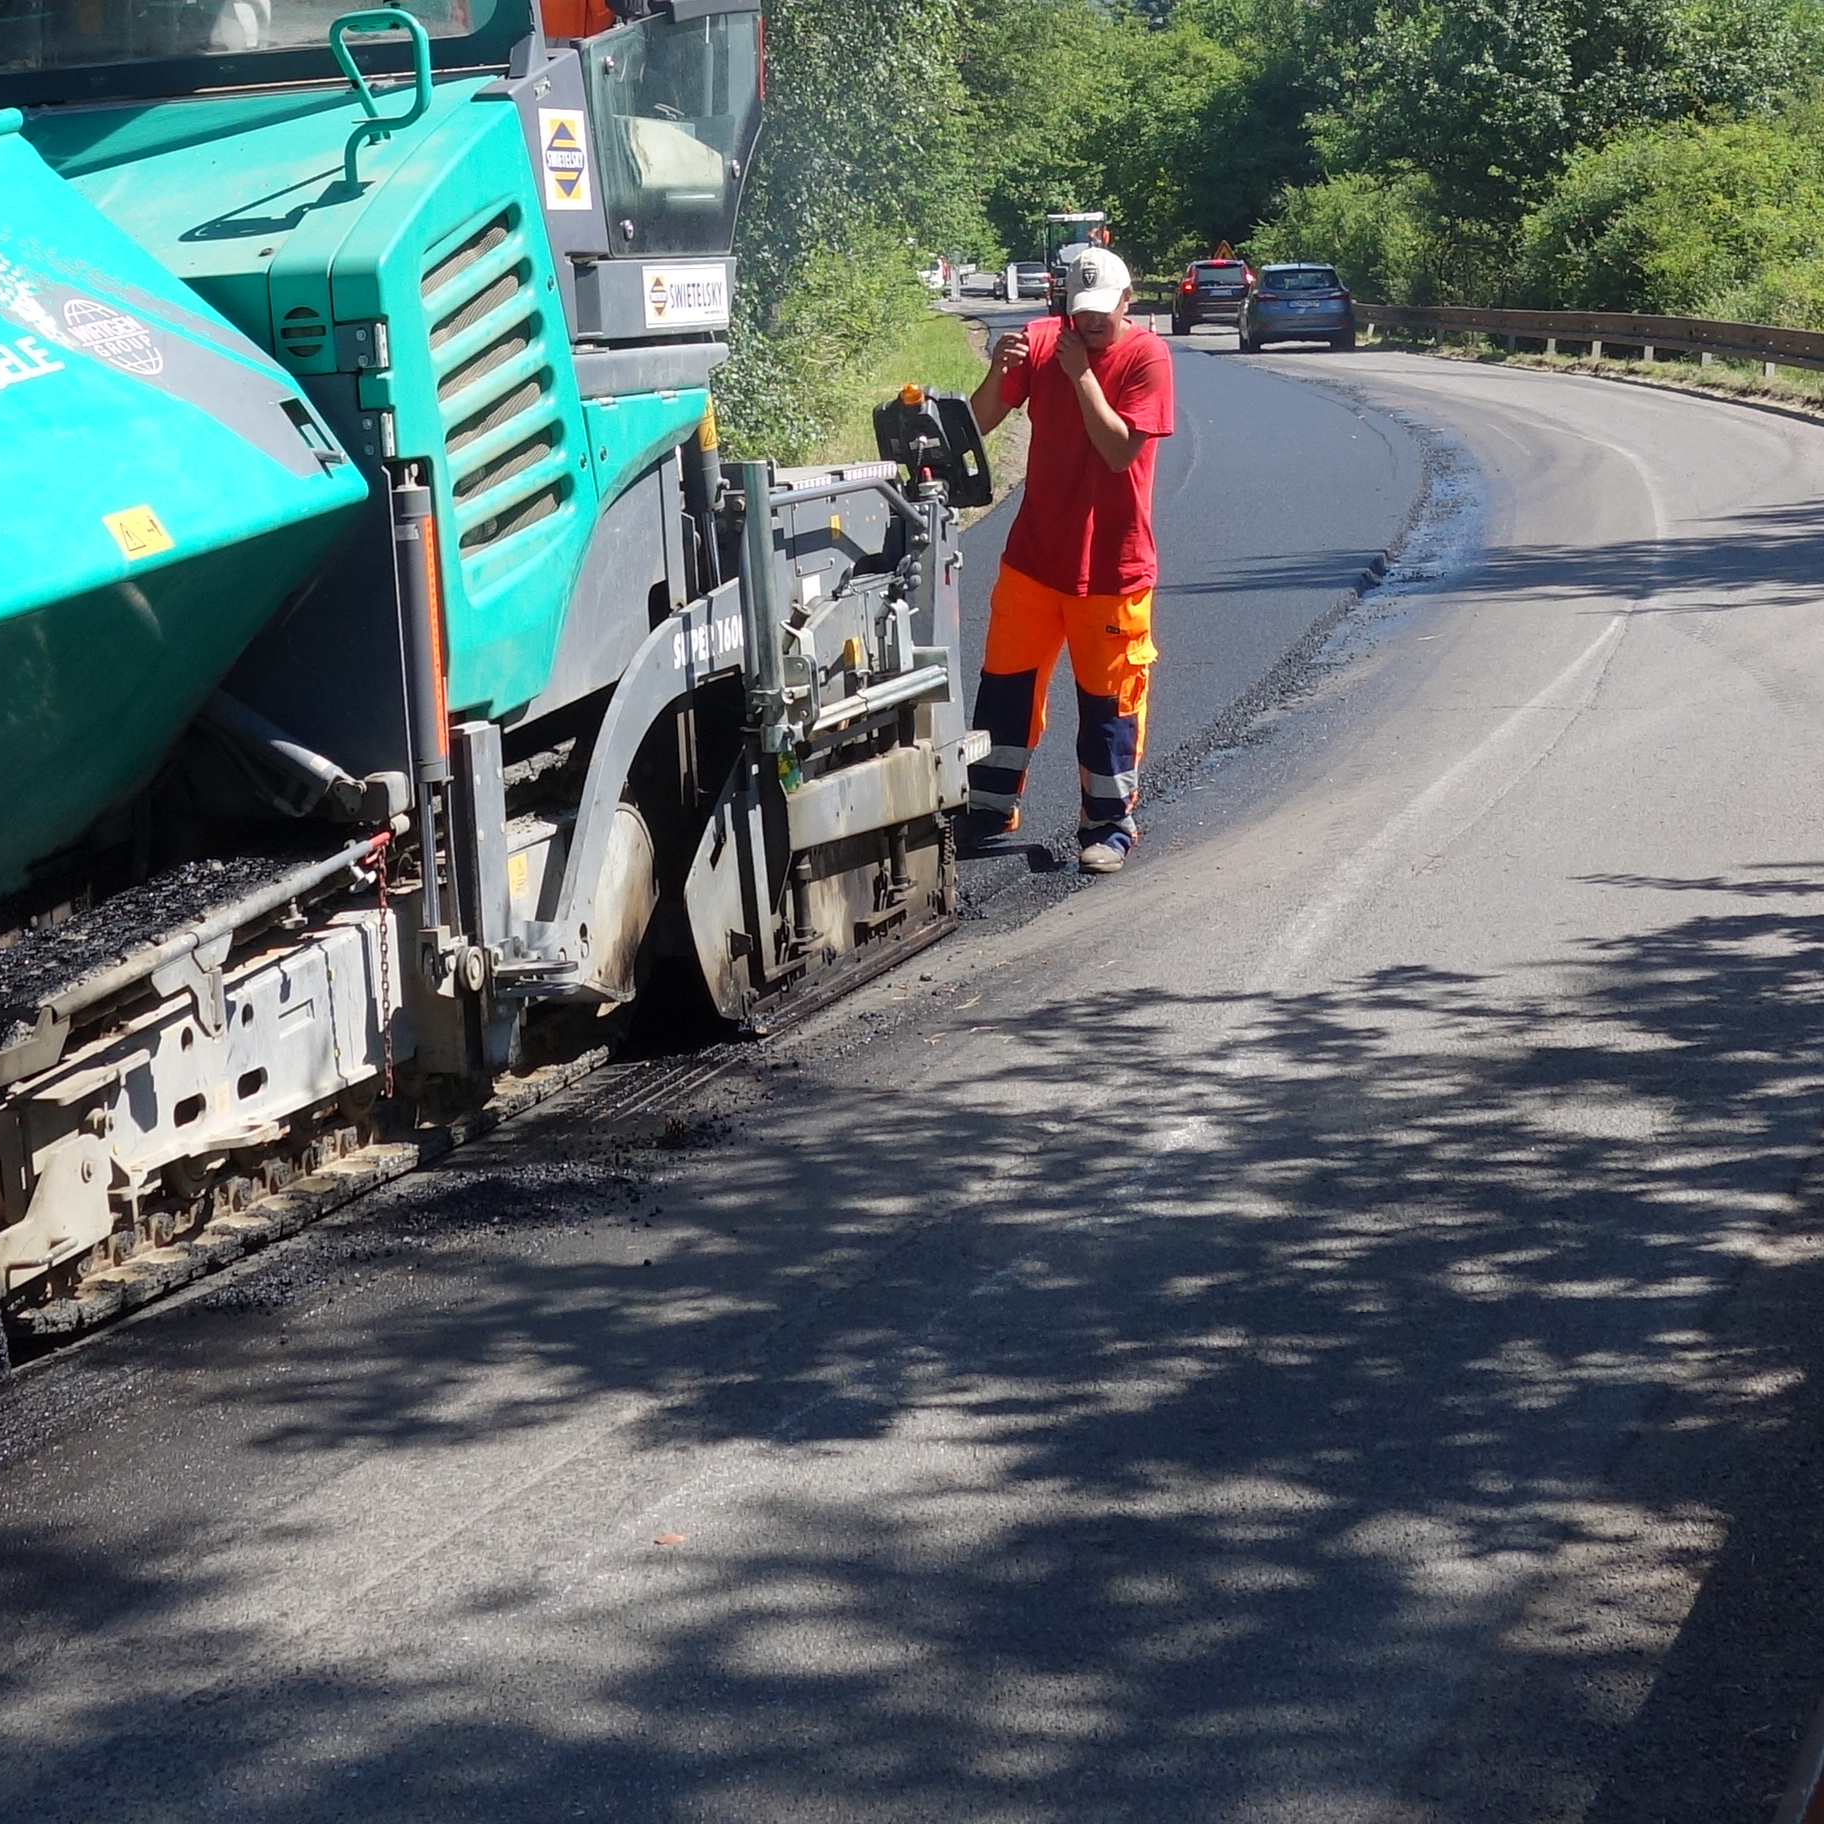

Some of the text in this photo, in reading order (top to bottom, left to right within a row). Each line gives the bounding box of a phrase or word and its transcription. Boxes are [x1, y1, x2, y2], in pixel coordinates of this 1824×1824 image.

[669, 281, 723, 309] SWIETELSKY
[66, 315, 144, 343] WIRTGEN
[93, 335, 152, 358] GROUP
[673, 624, 716, 670] SUPER
